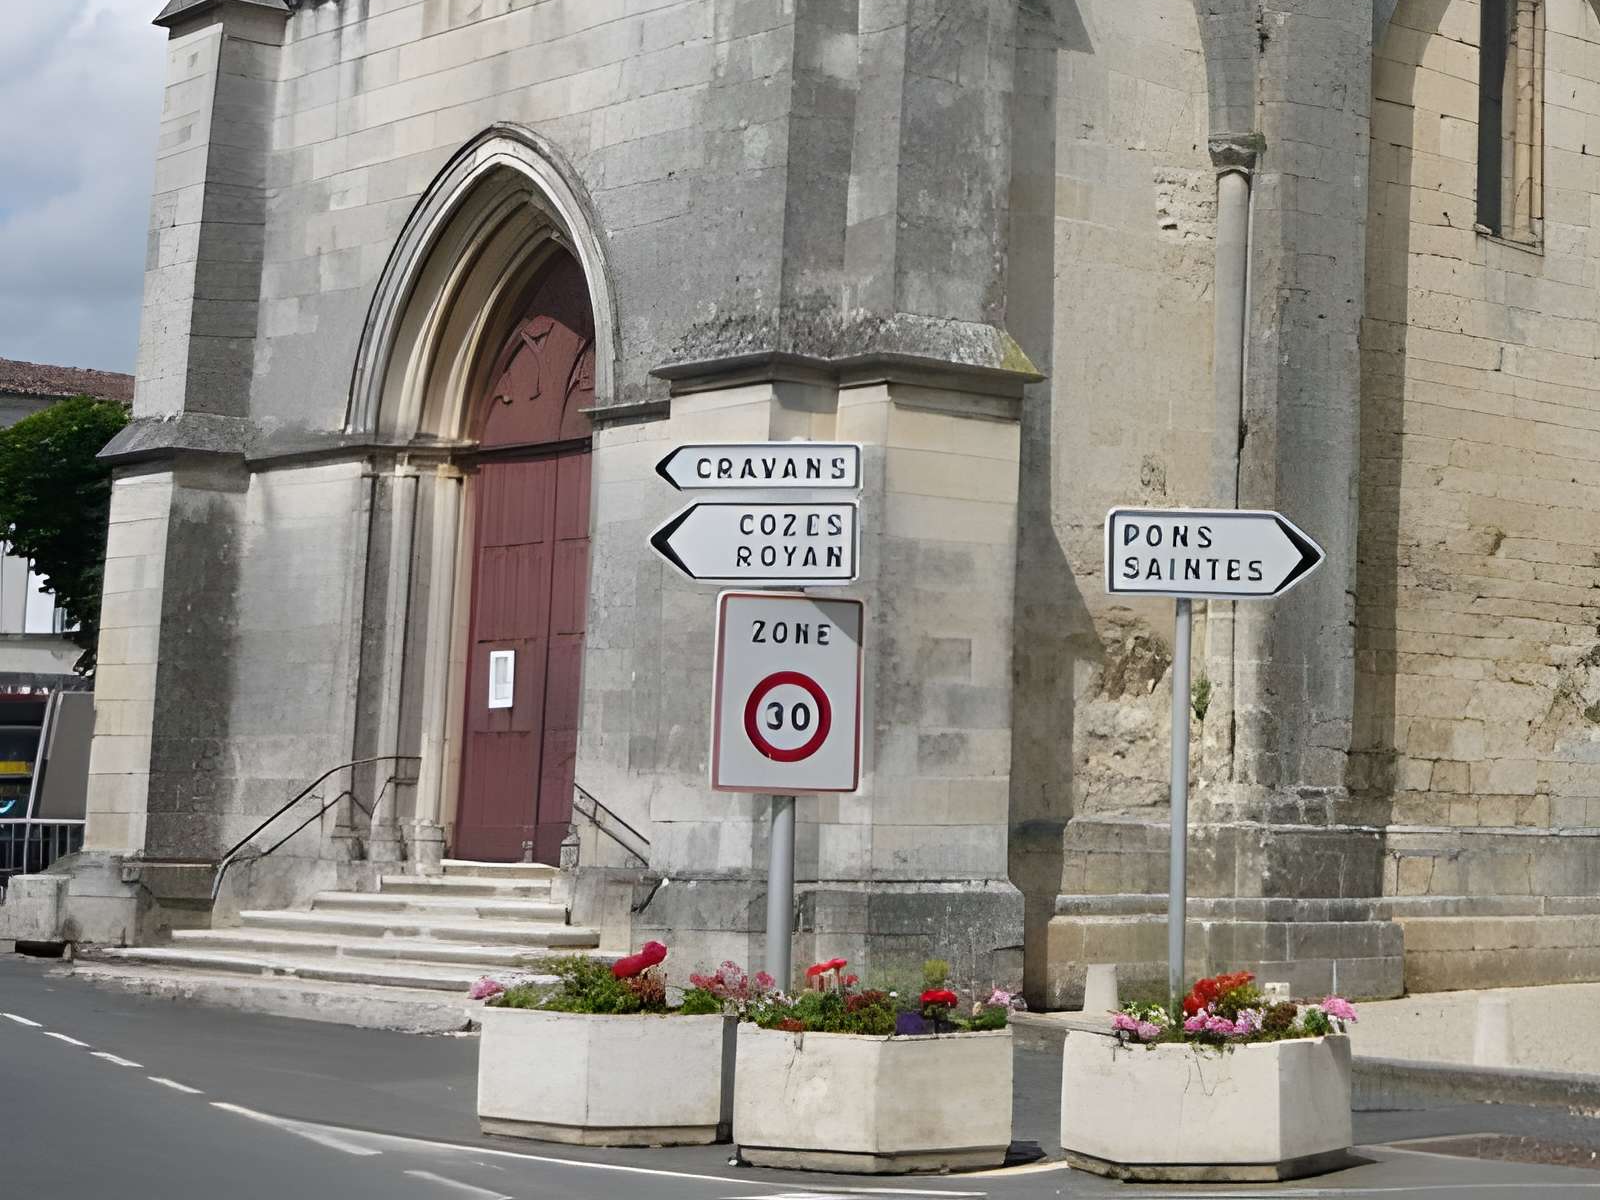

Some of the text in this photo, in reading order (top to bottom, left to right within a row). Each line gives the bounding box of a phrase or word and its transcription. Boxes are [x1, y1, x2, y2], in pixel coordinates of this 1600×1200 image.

[696, 457, 845, 480] CRAVANS
[740, 513, 842, 537] COZES
[1123, 523, 1213, 548] PONS
[736, 545, 842, 567] ROYAN
[1122, 556, 1263, 581] SAINTES
[752, 620, 831, 646] ZONE
[766, 701, 811, 731] 30
